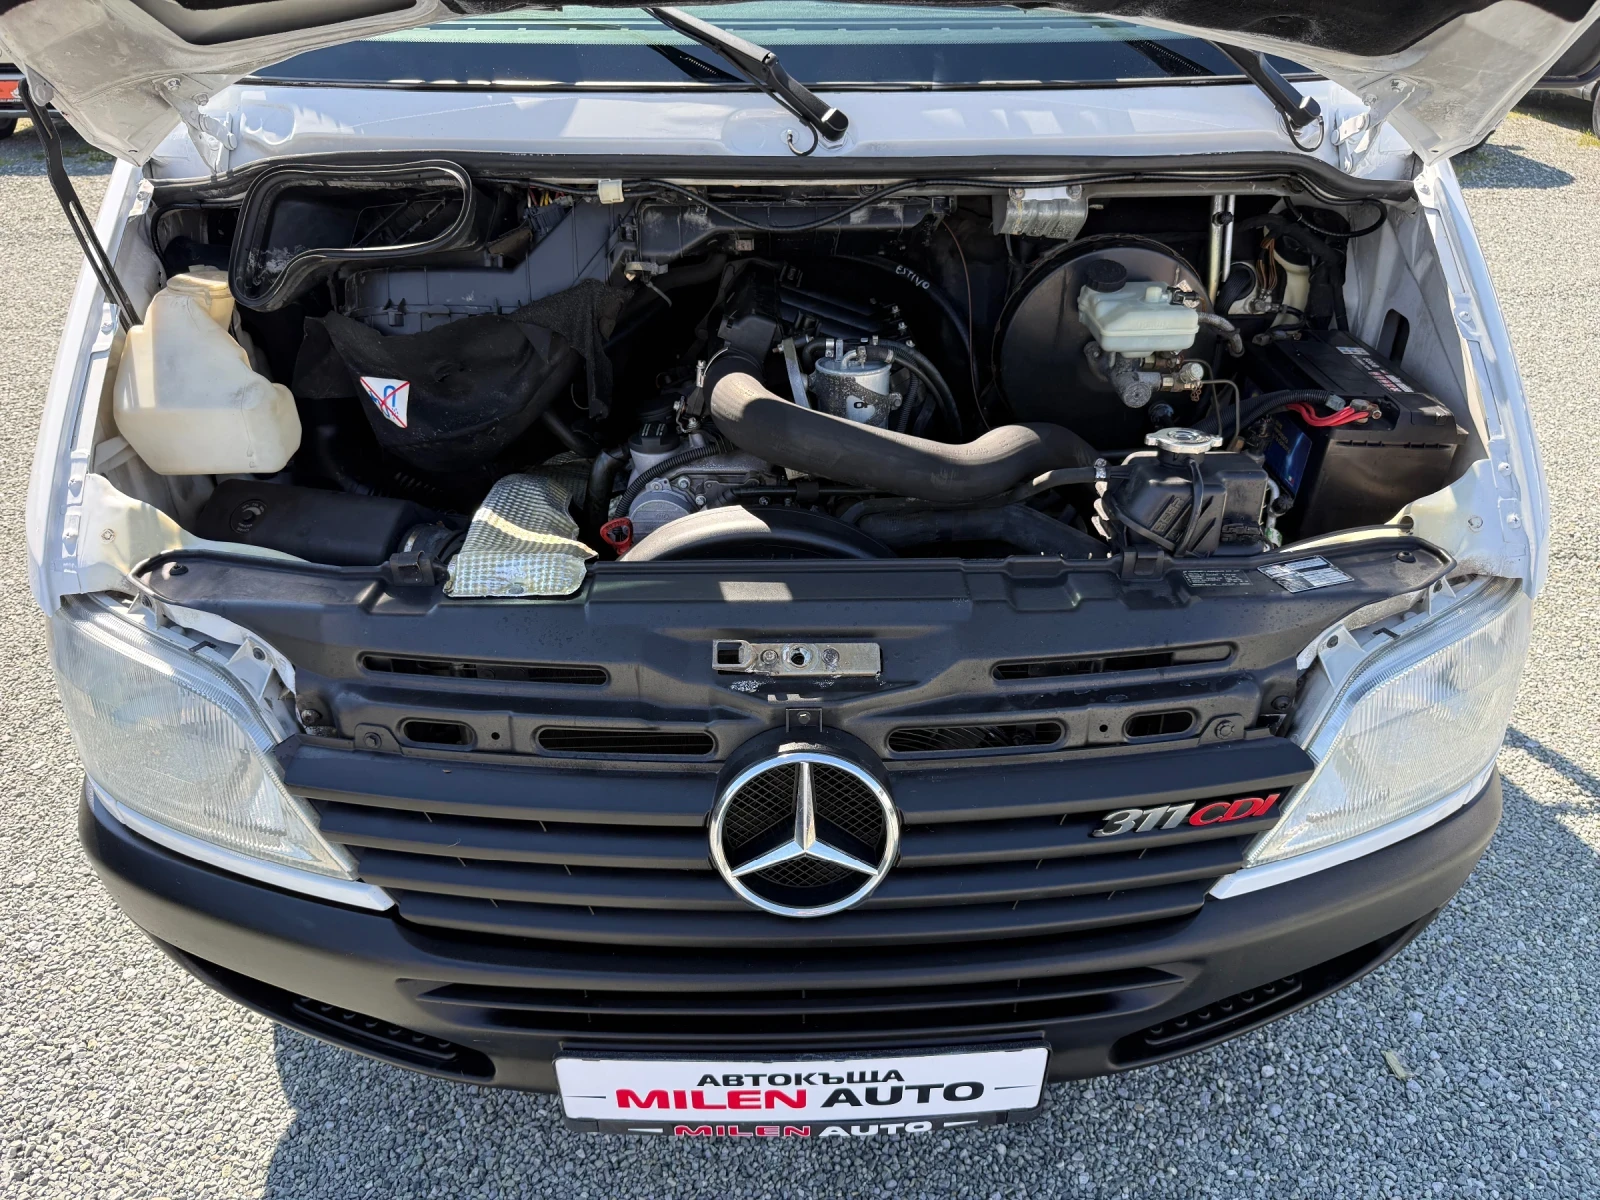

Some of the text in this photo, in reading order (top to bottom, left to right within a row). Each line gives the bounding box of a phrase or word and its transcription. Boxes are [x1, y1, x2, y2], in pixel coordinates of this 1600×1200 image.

[896, 265, 930, 289] ESTIVO
[697, 1069, 905, 1087] АВТОКЪША
[616, 1081, 984, 1109] MILEN AUTO
[674, 1121, 932, 1137] MILEN AUTO
